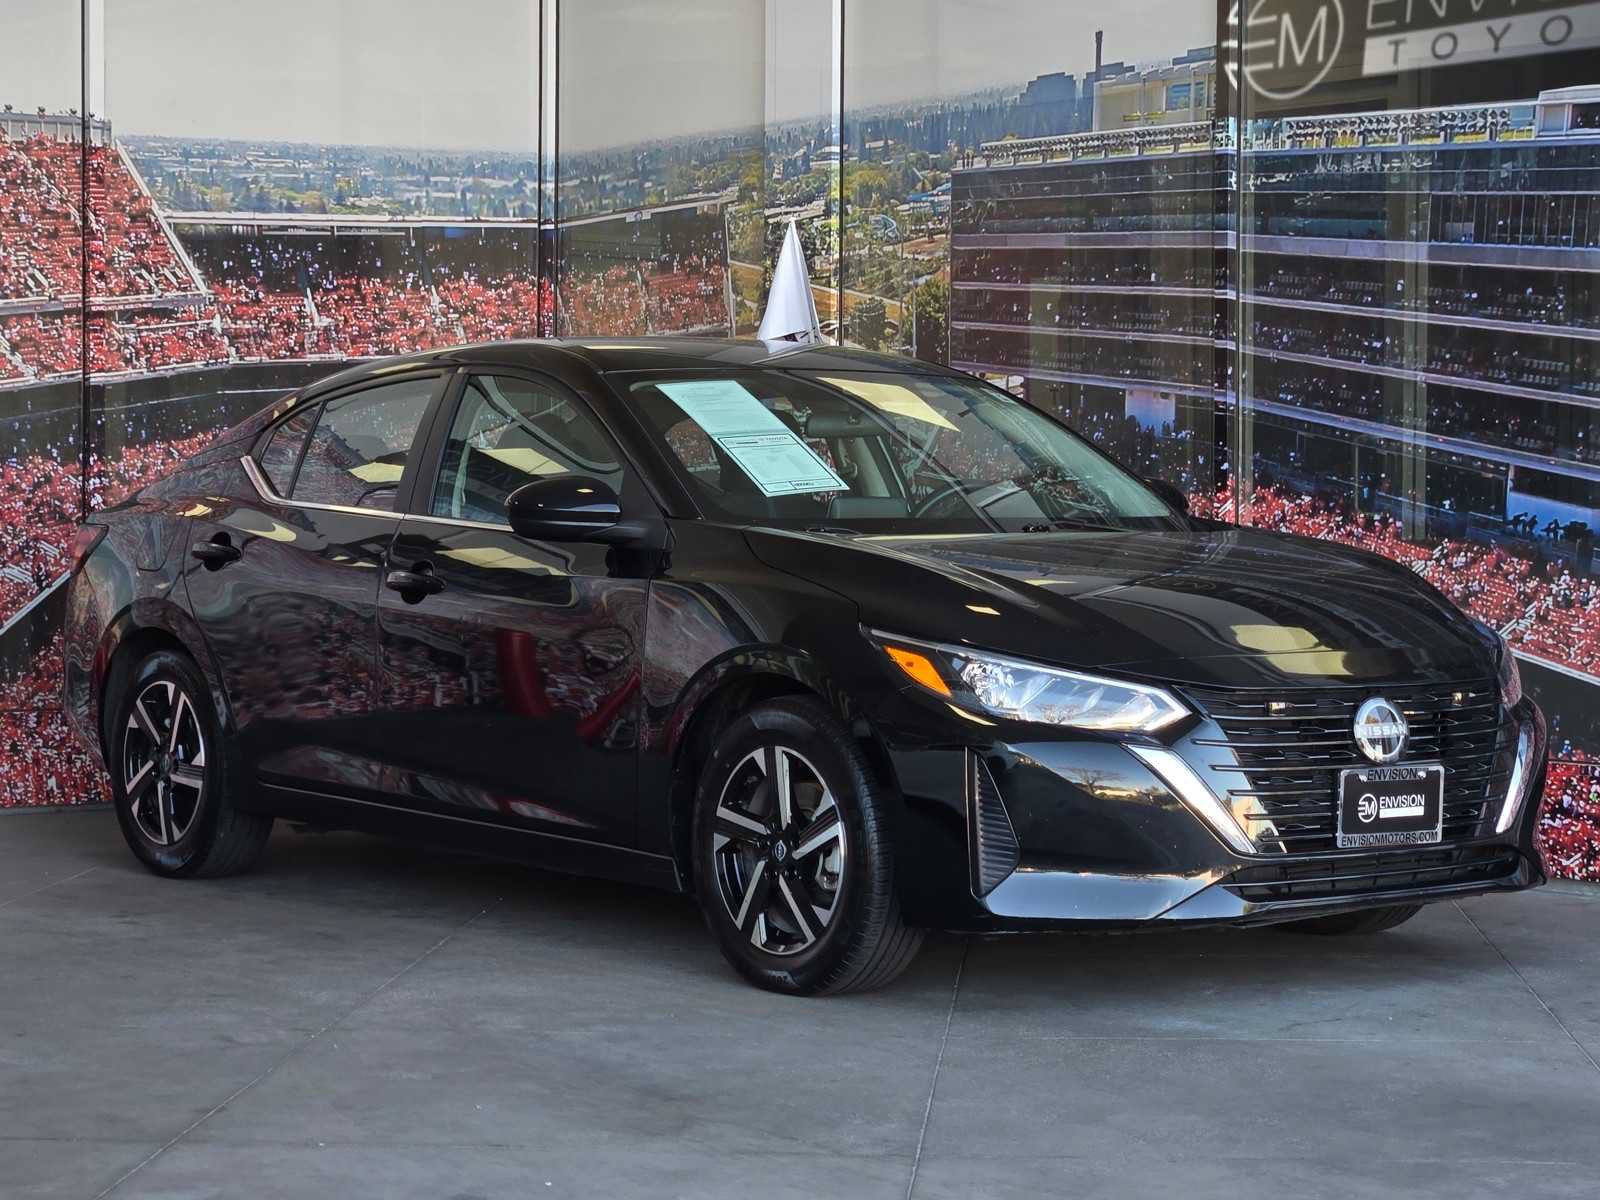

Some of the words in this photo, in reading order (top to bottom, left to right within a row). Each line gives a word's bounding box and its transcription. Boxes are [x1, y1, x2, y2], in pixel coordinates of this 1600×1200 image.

[1368, 768, 1418, 781] ENVISION
[1379, 794, 1425, 809] ENVISION
[1341, 831, 1438, 847] ENVISIONMOTORS.COM
